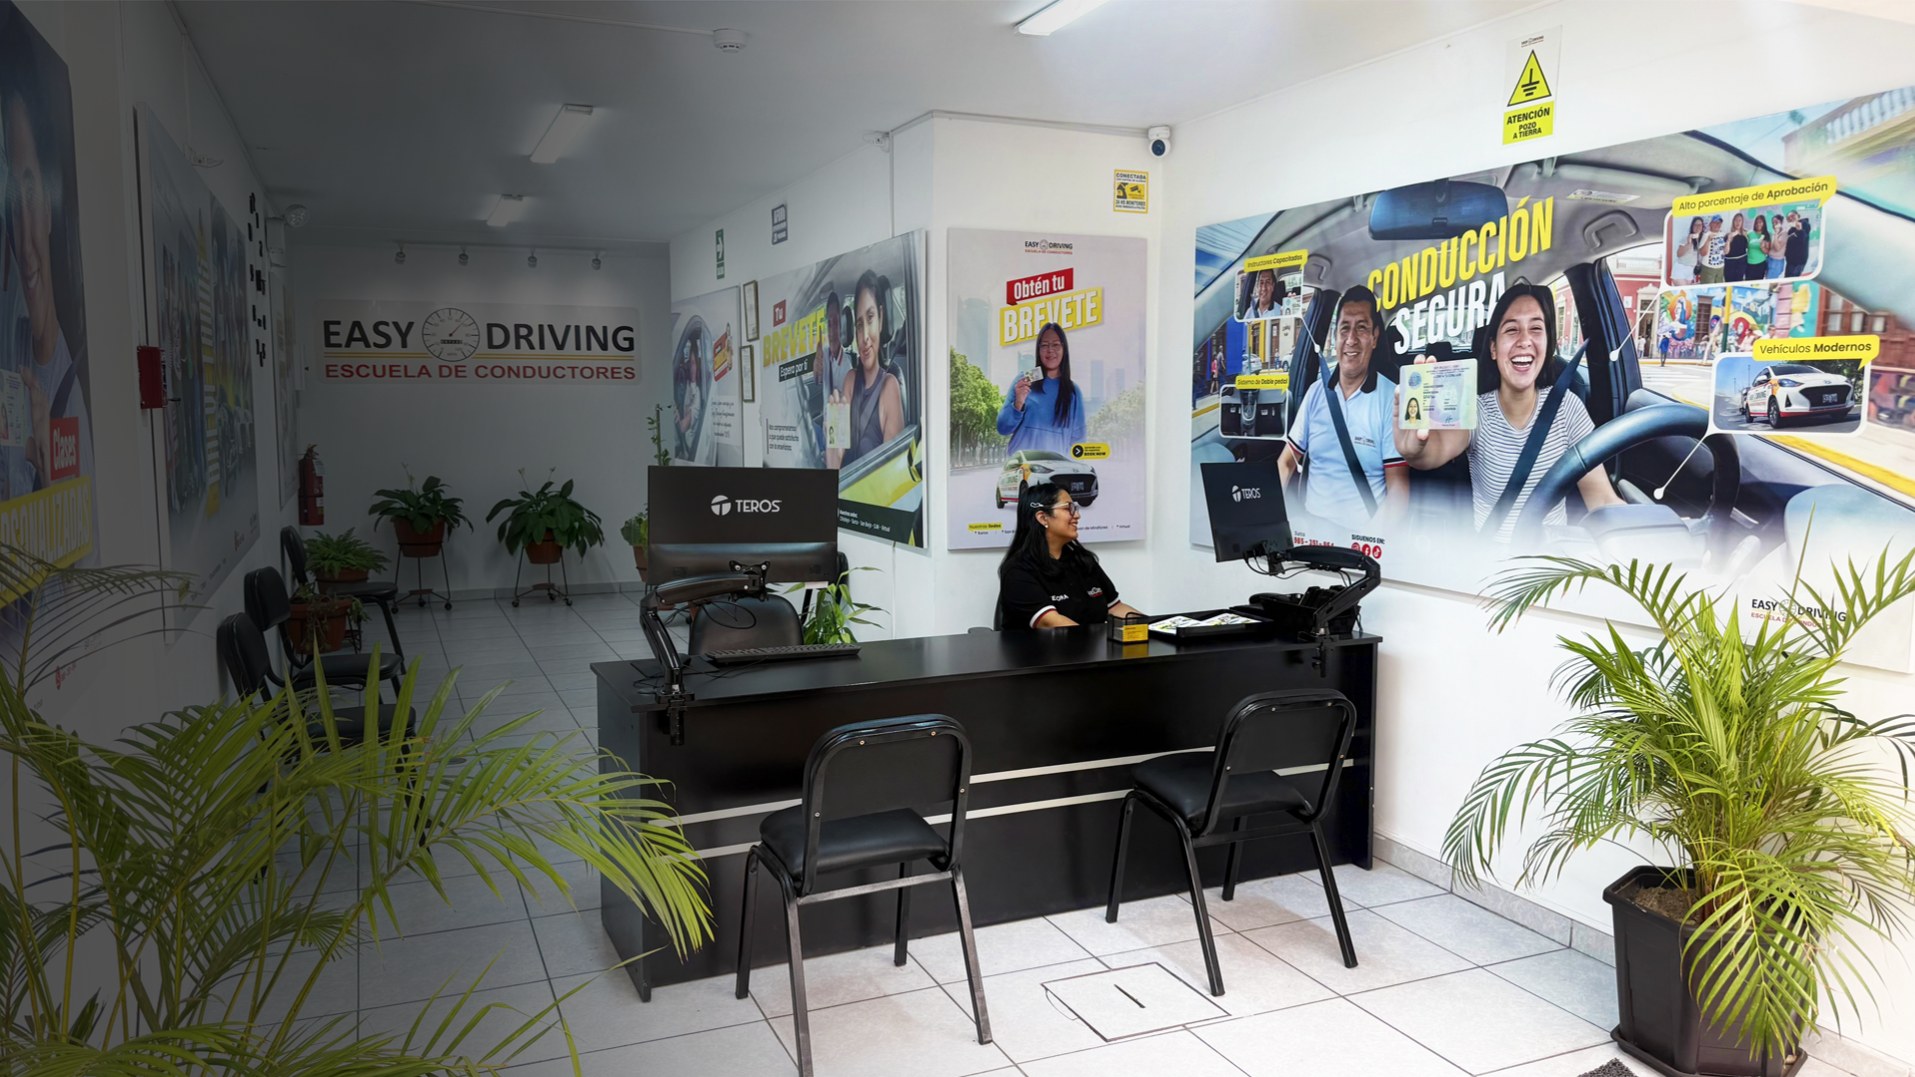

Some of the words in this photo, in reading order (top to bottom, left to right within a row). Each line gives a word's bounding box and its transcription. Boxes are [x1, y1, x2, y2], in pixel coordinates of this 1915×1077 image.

[1506, 106, 1551, 125] ATENCIÓN
[1518, 121, 1537, 131] POZO
[1518, 127, 1542, 138] TIERRA
[1679, 201, 1697, 211] Alto
[1698, 193, 1749, 211] porcentaje
[1751, 191, 1765, 201] de
[1766, 181, 1829, 199] Aprobación
[1024, 240, 1039, 248] EASY
[1048, 242, 1073, 250] DRIVING
[1367, 194, 1554, 313] CONDUCCIÓN
[1014, 276, 1050, 300] Obtén
[1052, 274, 1065, 292] tu
[774, 306, 784, 322] Tu
[1004, 290, 1098, 343] BREVETE
[1389, 270, 1506, 354] SEGURA
[323, 319, 415, 349] EASY
[486, 322, 635, 352] DRIVING
[1760, 343, 1811, 354] Vehículos
[1813, 341, 1872, 353] Modernos
[325, 364, 432, 379] ESCUELA
[438, 364, 468, 379] DE
[474, 365, 636, 380] CONDUCTORES
[53, 427, 77, 471] Clases
[1241, 487, 1261, 499] TEROS
[735, 499, 783, 513] TEROS
[1751, 598, 1778, 611] EASY
